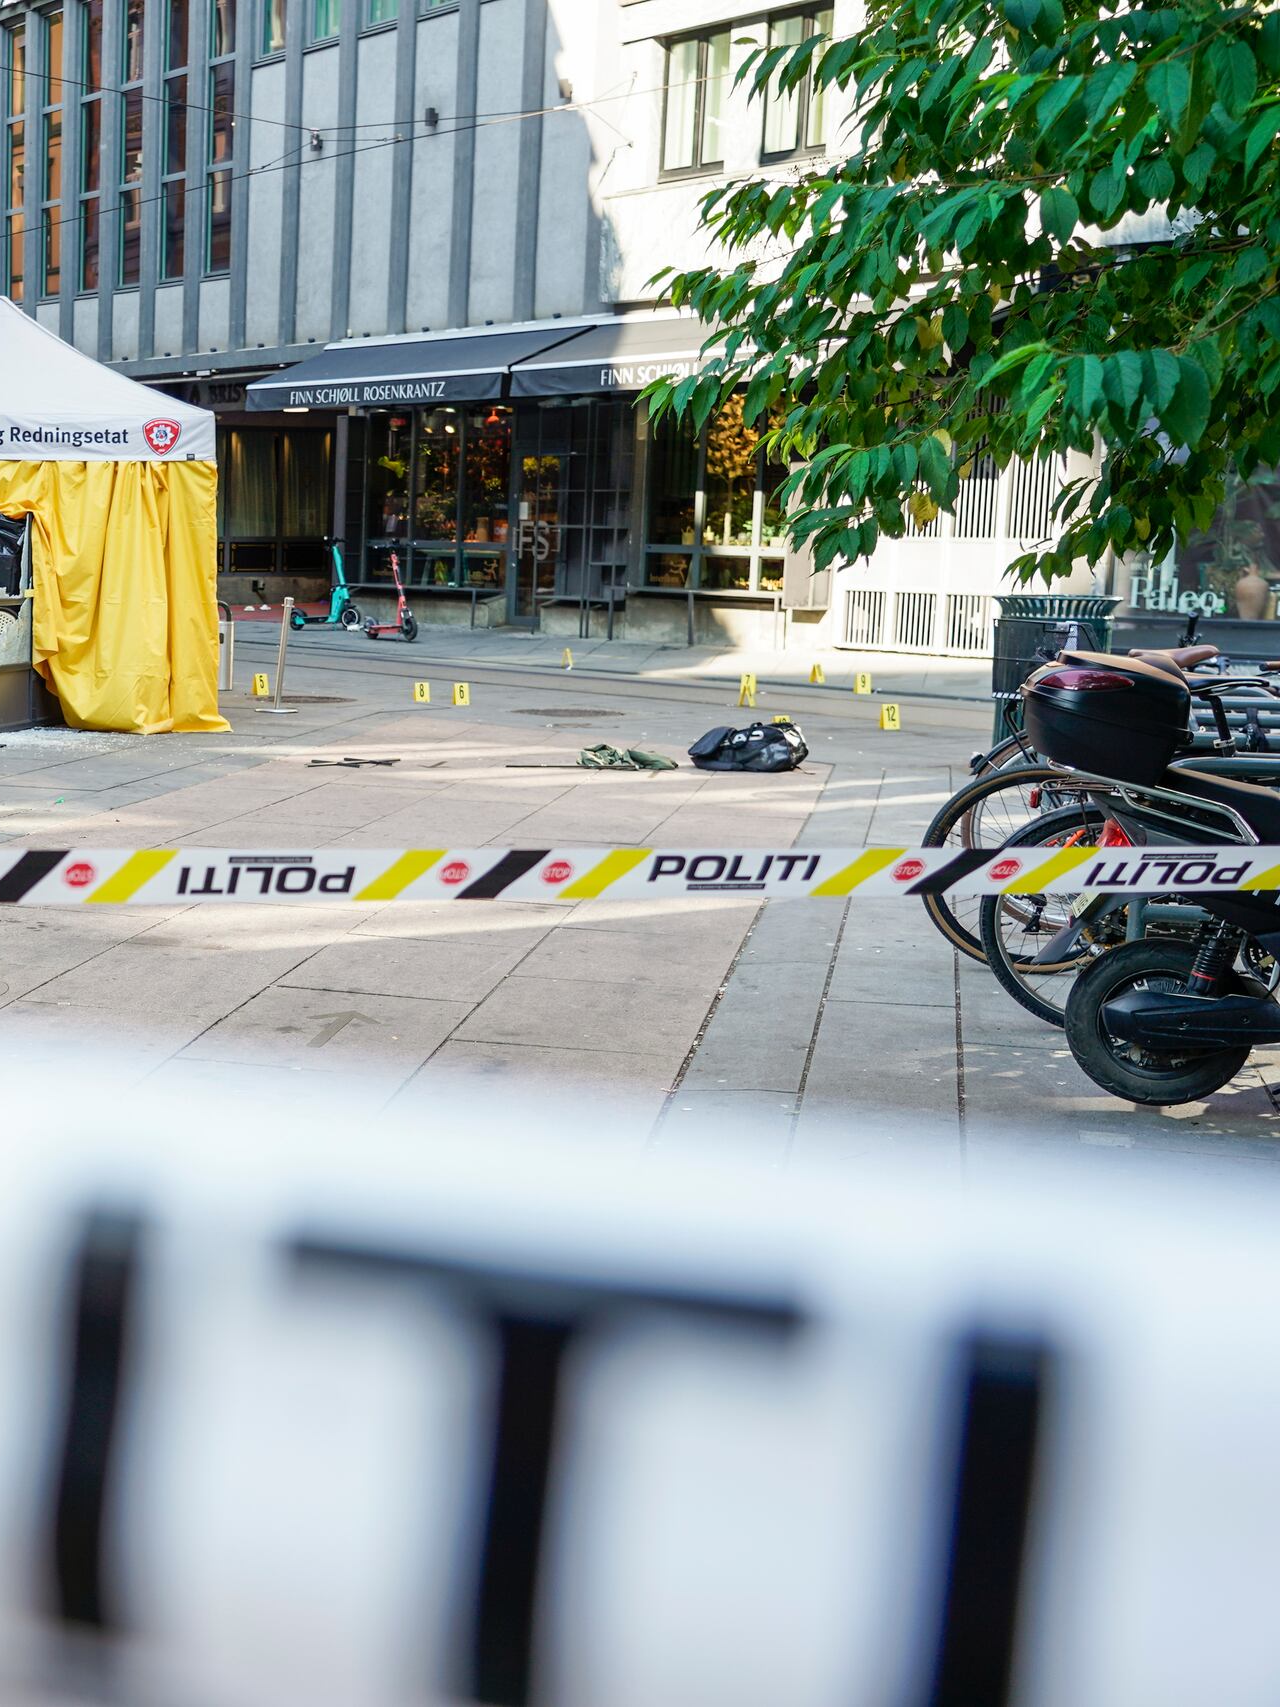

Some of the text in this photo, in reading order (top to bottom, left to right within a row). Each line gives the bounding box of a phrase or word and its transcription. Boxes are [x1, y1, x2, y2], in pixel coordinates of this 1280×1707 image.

[601, 368, 633, 386] FINN
[290, 381, 446, 405] FINN SCHJØLL ROSENKRANTZ
[10, 427, 128, 447] Redningsetat
[745, 674, 750, 684] 7
[861, 674, 866, 688] 9
[420, 683, 424, 697] 8
[459, 685, 464, 699] 6
[886, 706, 896, 722] 12
[543, 868, 570, 879] STOP
[647, 855, 821, 882] POLITI
[894, 866, 921, 876] STOP
[991, 864, 1018, 875] STOP
[1083, 861, 1253, 886] POLITI
[177, 866, 355, 894] POLITI
